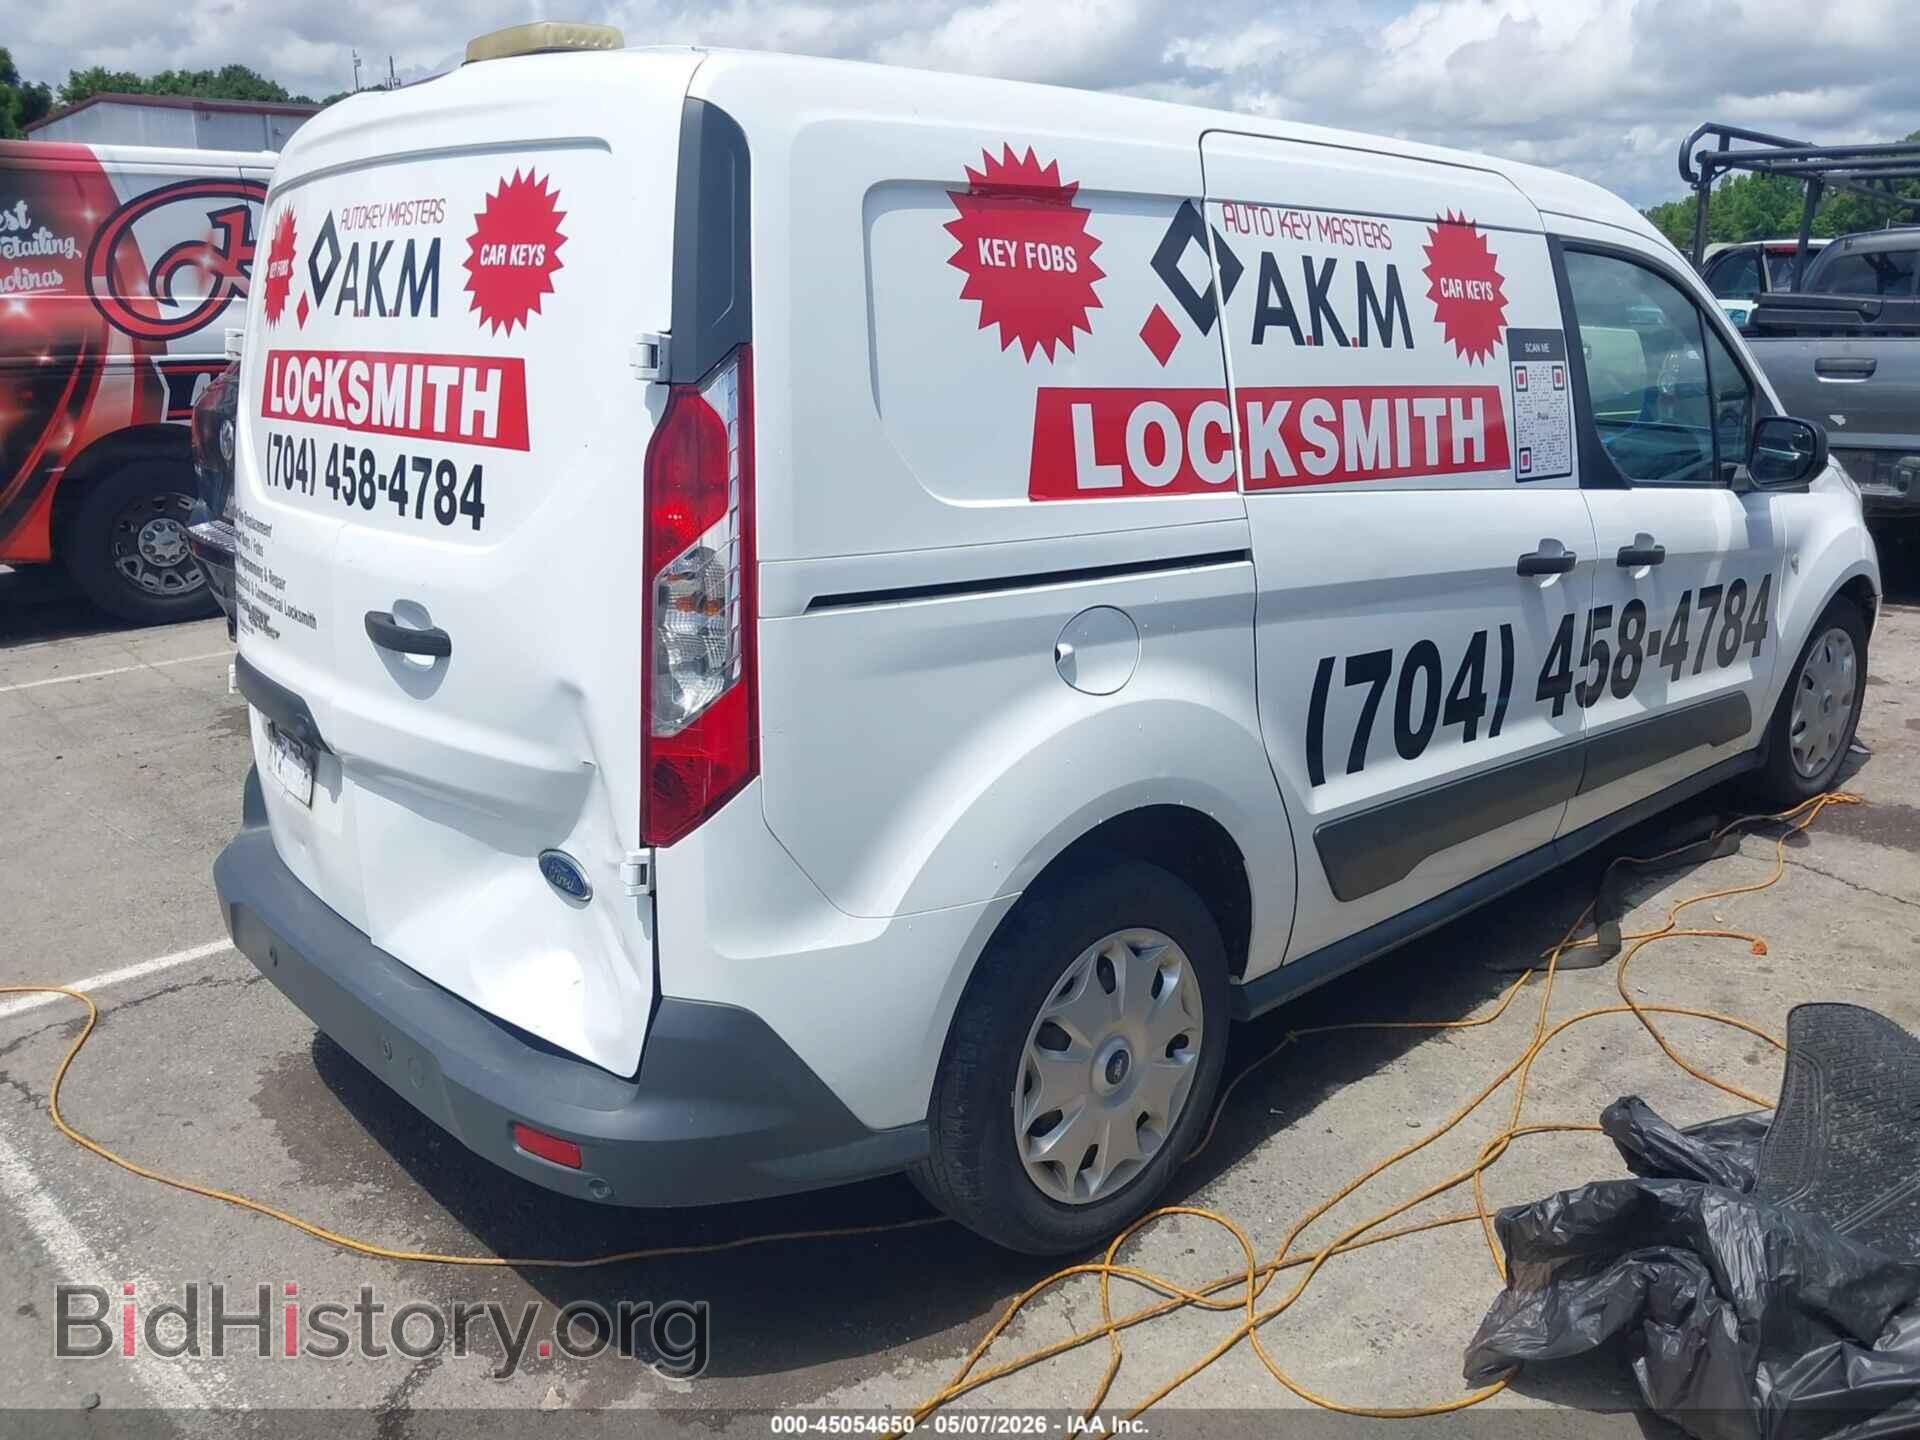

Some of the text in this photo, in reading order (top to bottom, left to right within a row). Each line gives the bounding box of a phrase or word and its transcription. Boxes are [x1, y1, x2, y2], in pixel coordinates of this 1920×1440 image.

[387, 198, 447, 227] MASTERS
[1223, 200, 1393, 250] AUTO KEY MASTERS
[334, 237, 441, 318] A.K.M
[479, 243, 546, 267] CAR KEYS
[977, 236, 1078, 273] KEY FOBS
[1440, 277, 1494, 302] CAR KEYS
[1251, 251, 1415, 349] A.K.M
[270, 356, 502, 439] LOCKSMITH
[267, 432, 485, 531] (704) 458-4784
[1071, 397, 1486, 490] LOCKSMITH
[1306, 574, 1773, 788] (704) 458-4784
